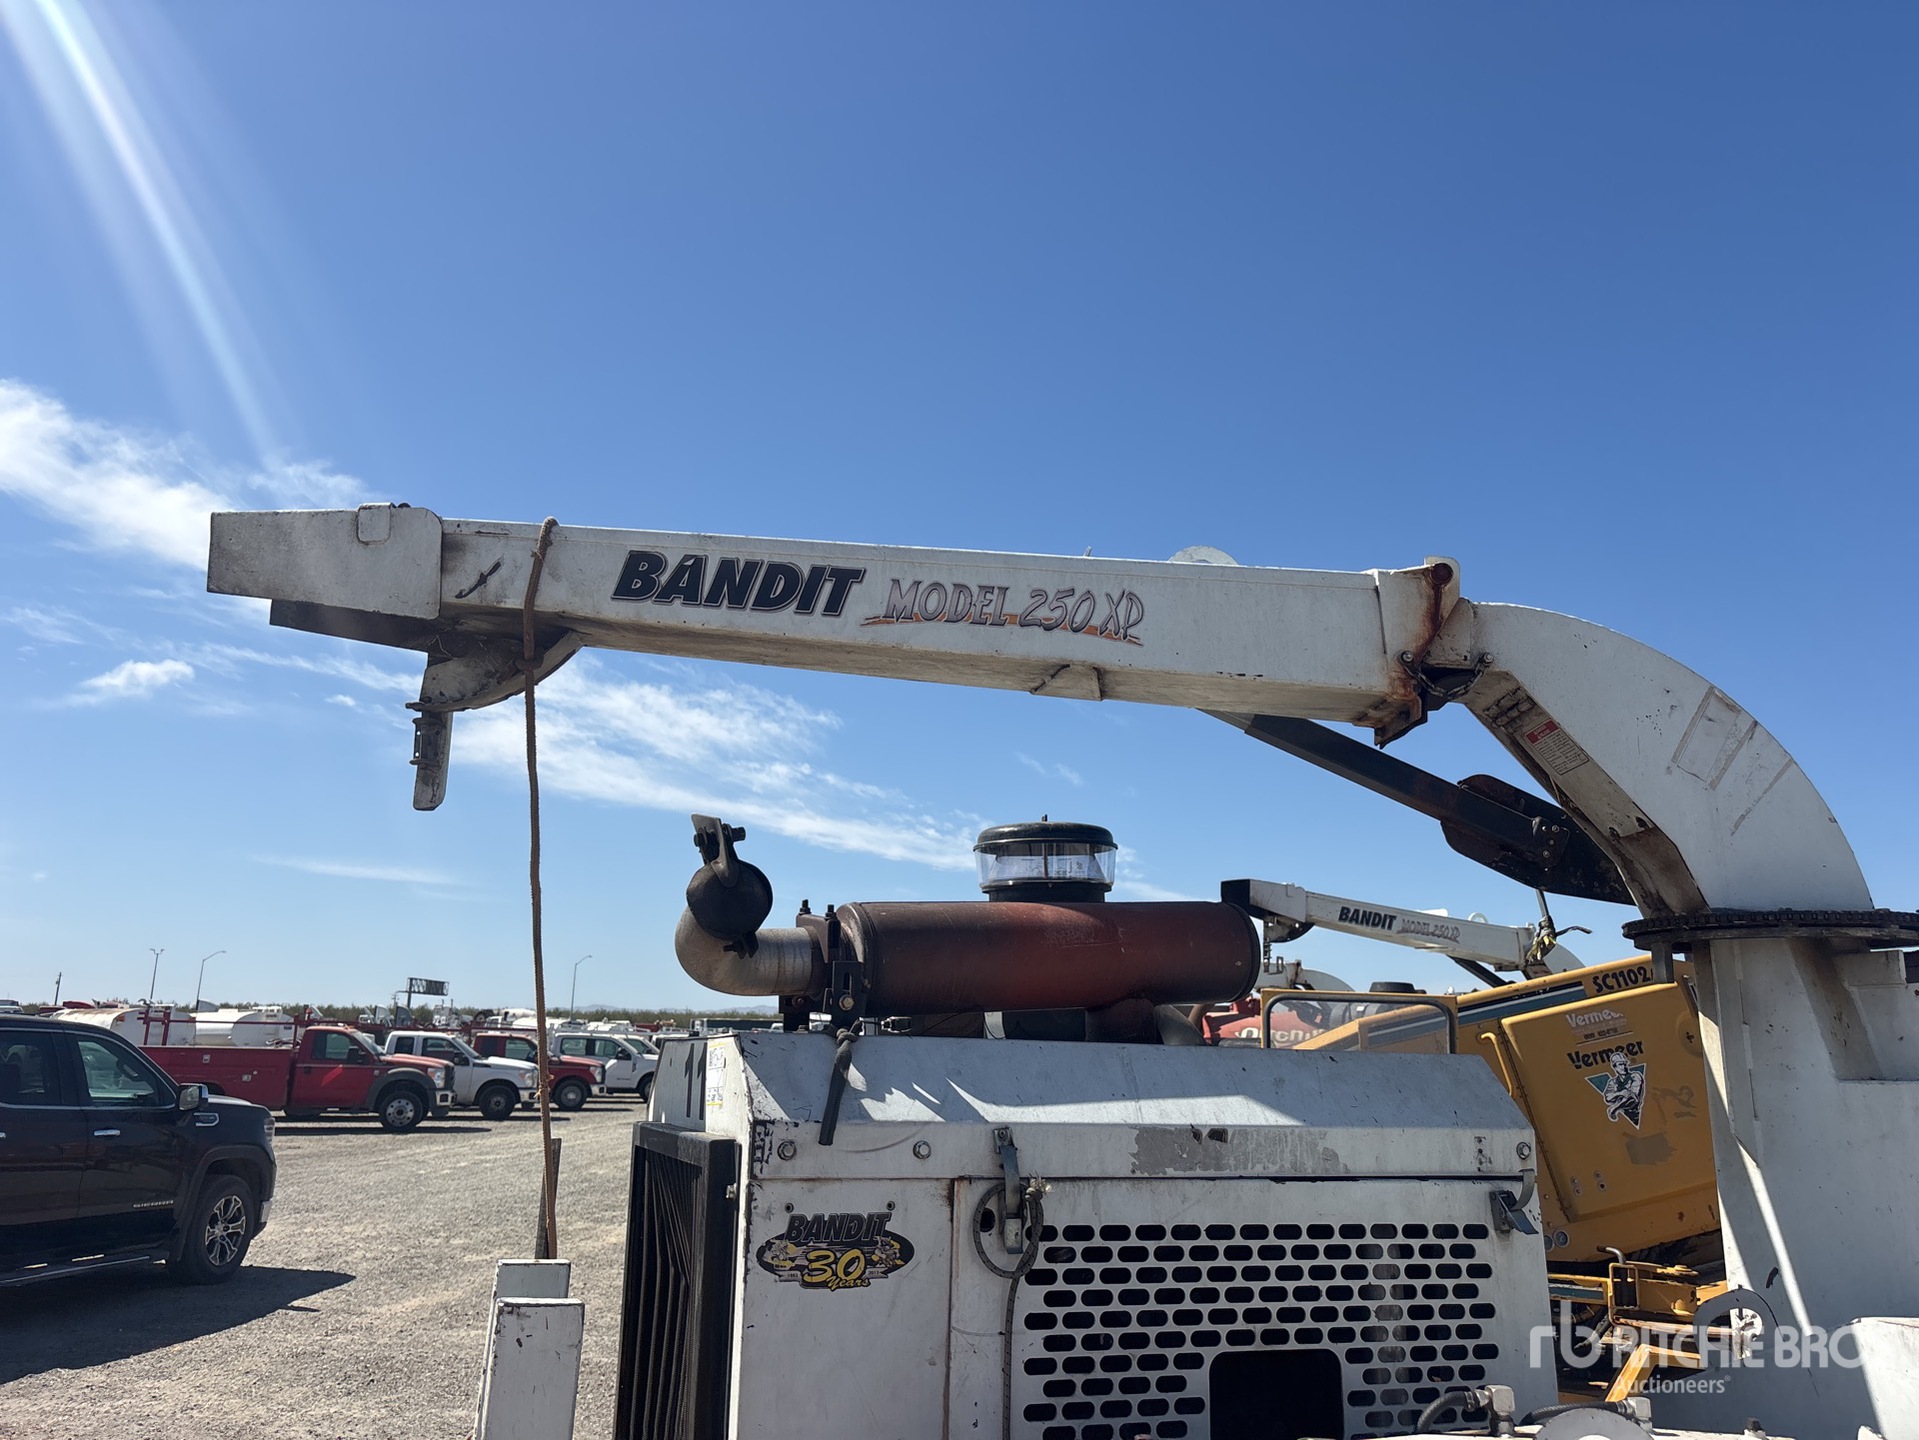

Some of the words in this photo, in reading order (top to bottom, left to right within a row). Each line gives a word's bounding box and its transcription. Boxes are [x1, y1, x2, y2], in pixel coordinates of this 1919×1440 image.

[610, 550, 866, 617] BANDIT
[884, 578, 1009, 627] MODEL
[1338, 906, 1397, 931] BANDIT
[1592, 966, 1653, 993] SC1102
[784, 1212, 892, 1242] BANDIT
[803, 1249, 866, 1283] 30
[826, 1276, 871, 1291] Years
